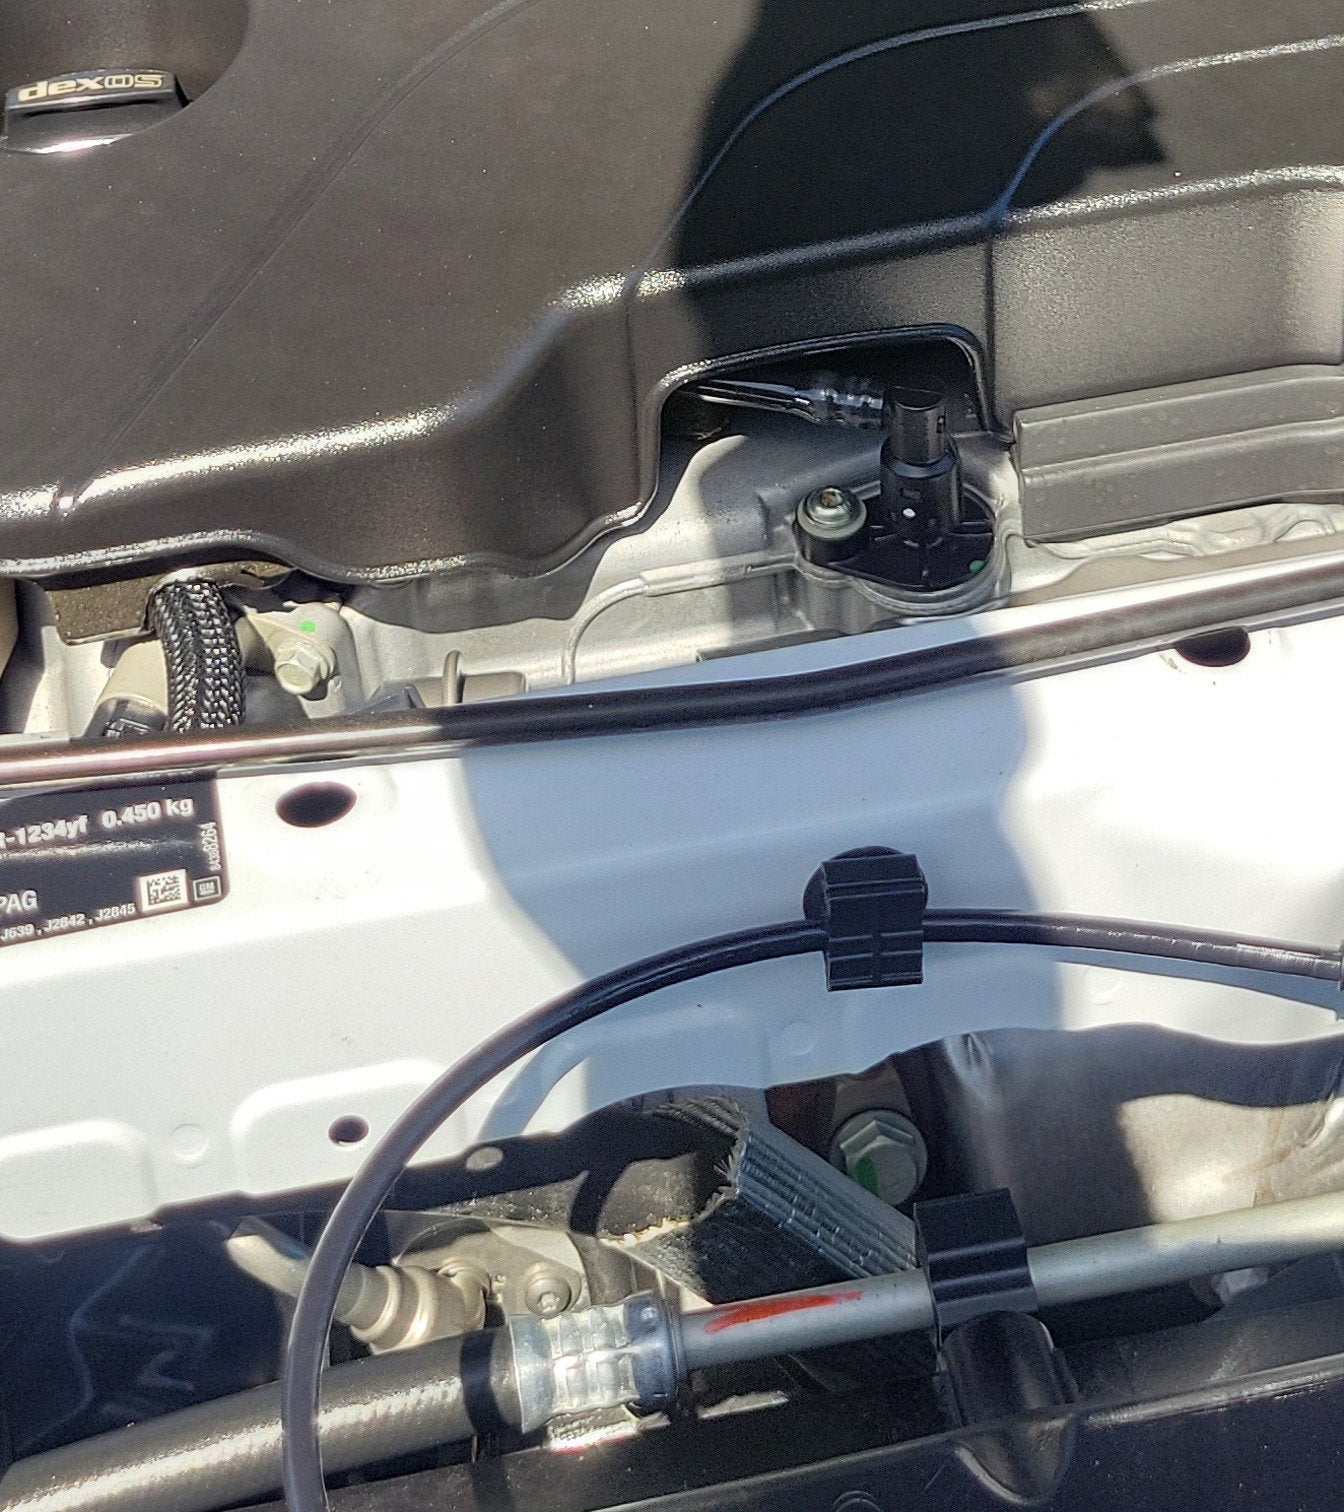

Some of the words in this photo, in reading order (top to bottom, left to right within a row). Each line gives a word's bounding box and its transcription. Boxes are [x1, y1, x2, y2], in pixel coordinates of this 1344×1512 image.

[17, 72, 164, 102] dexos
[101, 801, 162, 830] 0.450
[165, 795, 195, 820] kg
